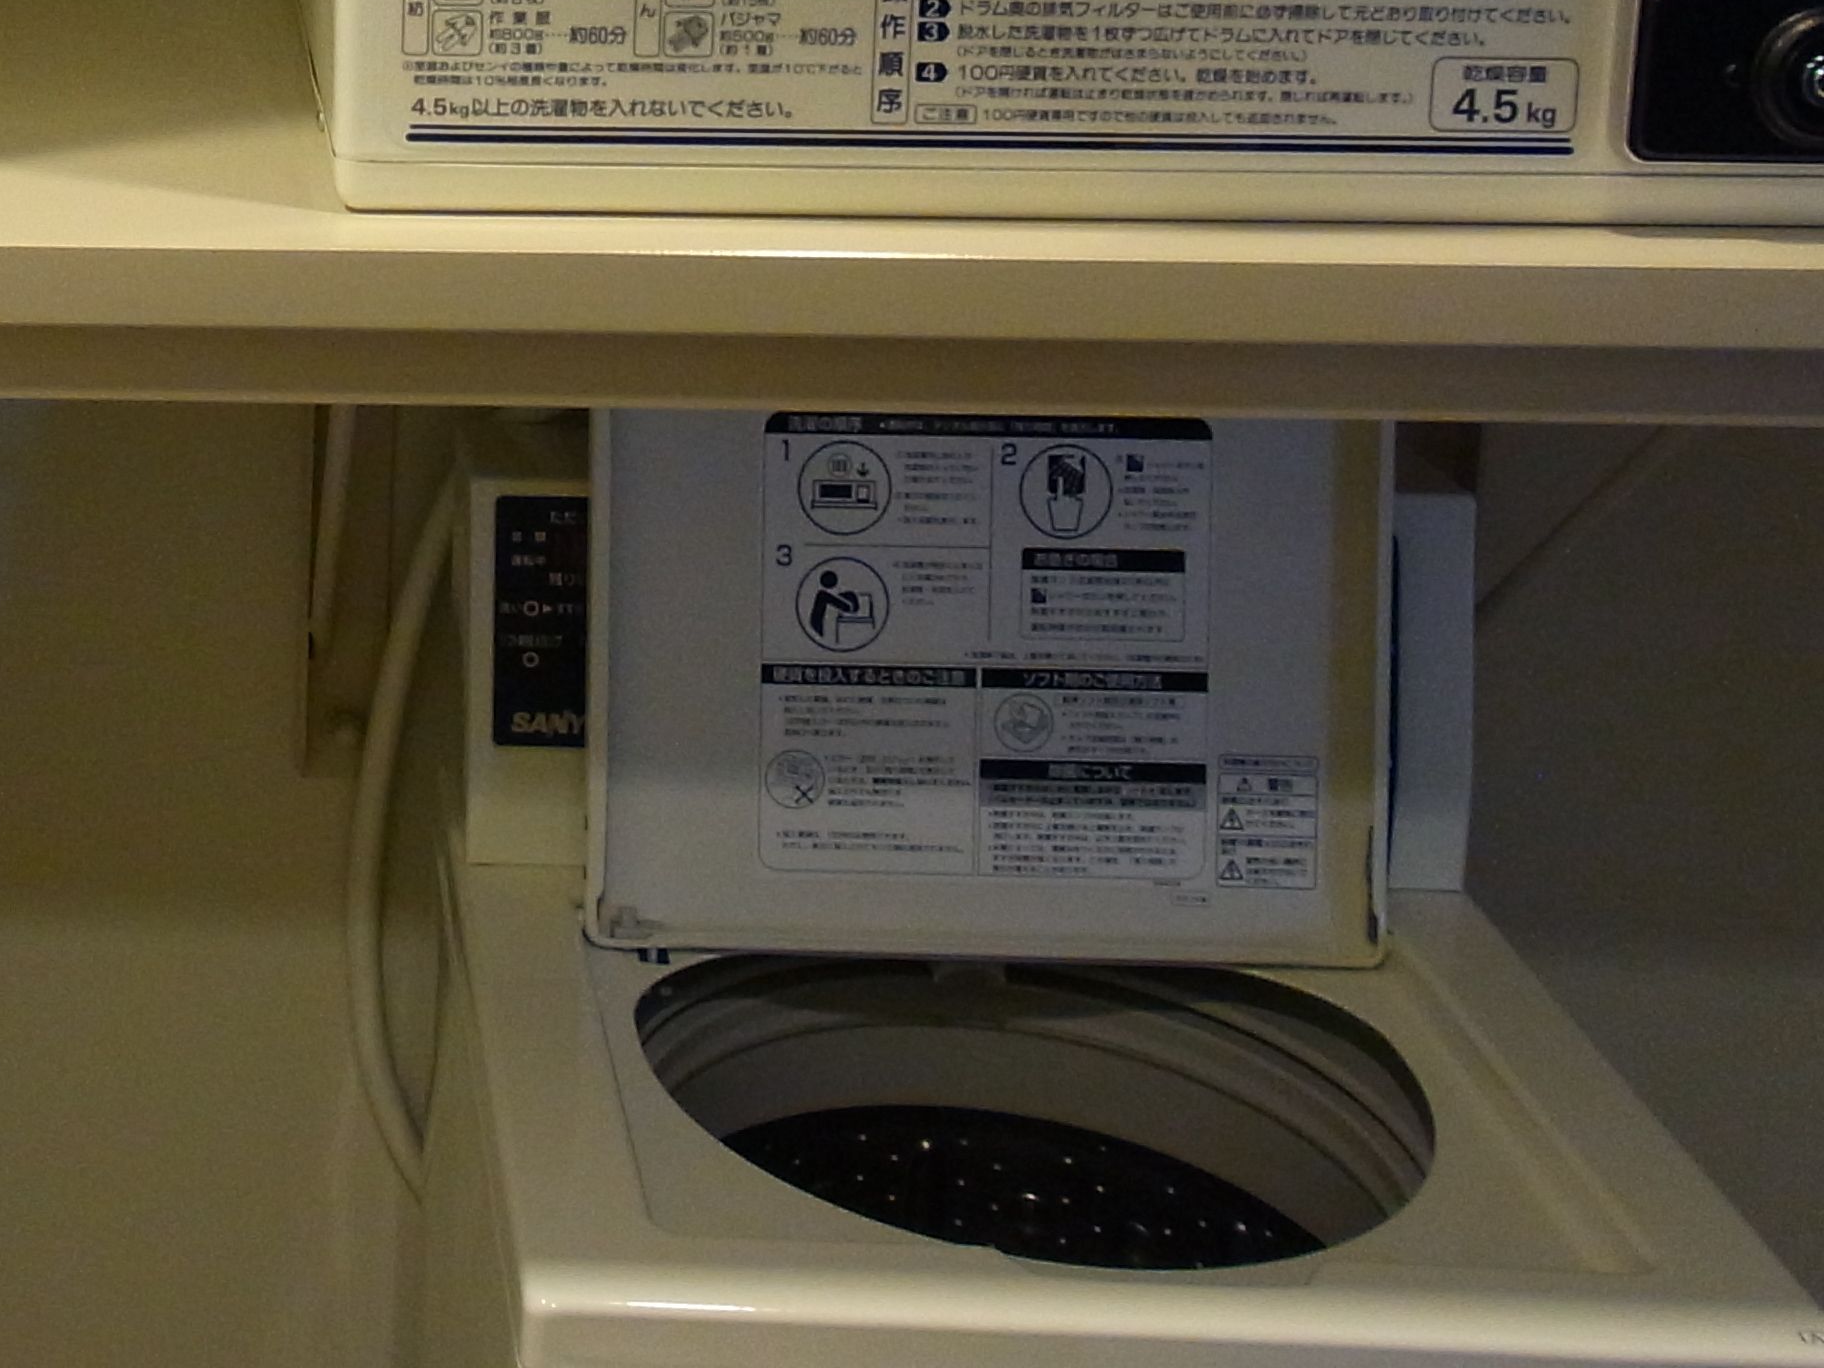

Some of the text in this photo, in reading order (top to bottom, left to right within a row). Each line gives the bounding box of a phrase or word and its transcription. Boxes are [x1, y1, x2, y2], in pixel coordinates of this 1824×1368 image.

[1452, 88, 1556, 128] 4.5 kg
[1001, 444, 1017, 465] 2
[776, 544, 793, 566] 3
